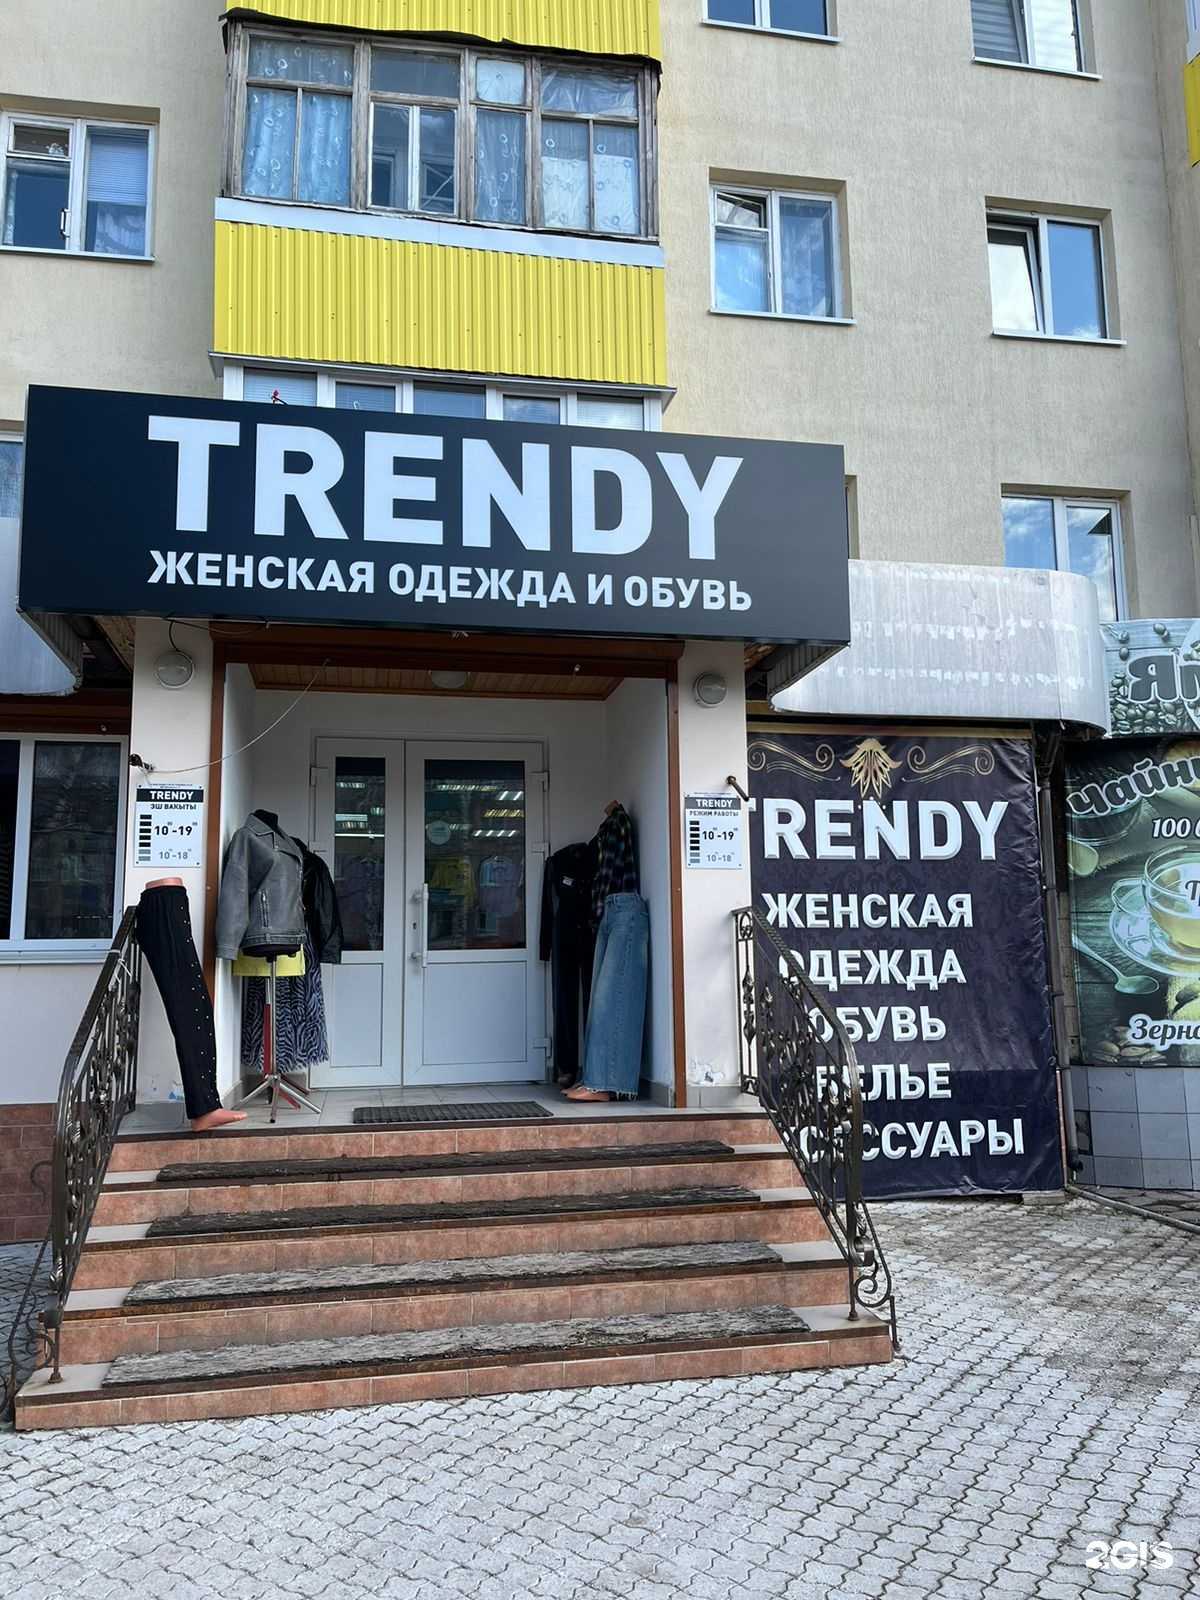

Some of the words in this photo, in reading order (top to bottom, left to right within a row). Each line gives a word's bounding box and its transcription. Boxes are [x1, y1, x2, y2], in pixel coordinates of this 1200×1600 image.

[148, 415, 744, 561] TRENDY
[147, 550, 375, 594] ЖЕНСКАЯ
[389, 563, 577, 609] ОДЕЖДА
[587, 573, 613, 606] И
[624, 575, 752, 611] ОБУВЬ
[150, 790, 194, 800] TRENDY
[696, 799, 733, 808] TRENDY
[747, 797, 1009, 860] RENDY
[1152, 817, 1191, 838] 100
[761, 893, 974, 929] ЖЕНСКАЯ
[808, 1006, 947, 1043] ОБУВЬ
